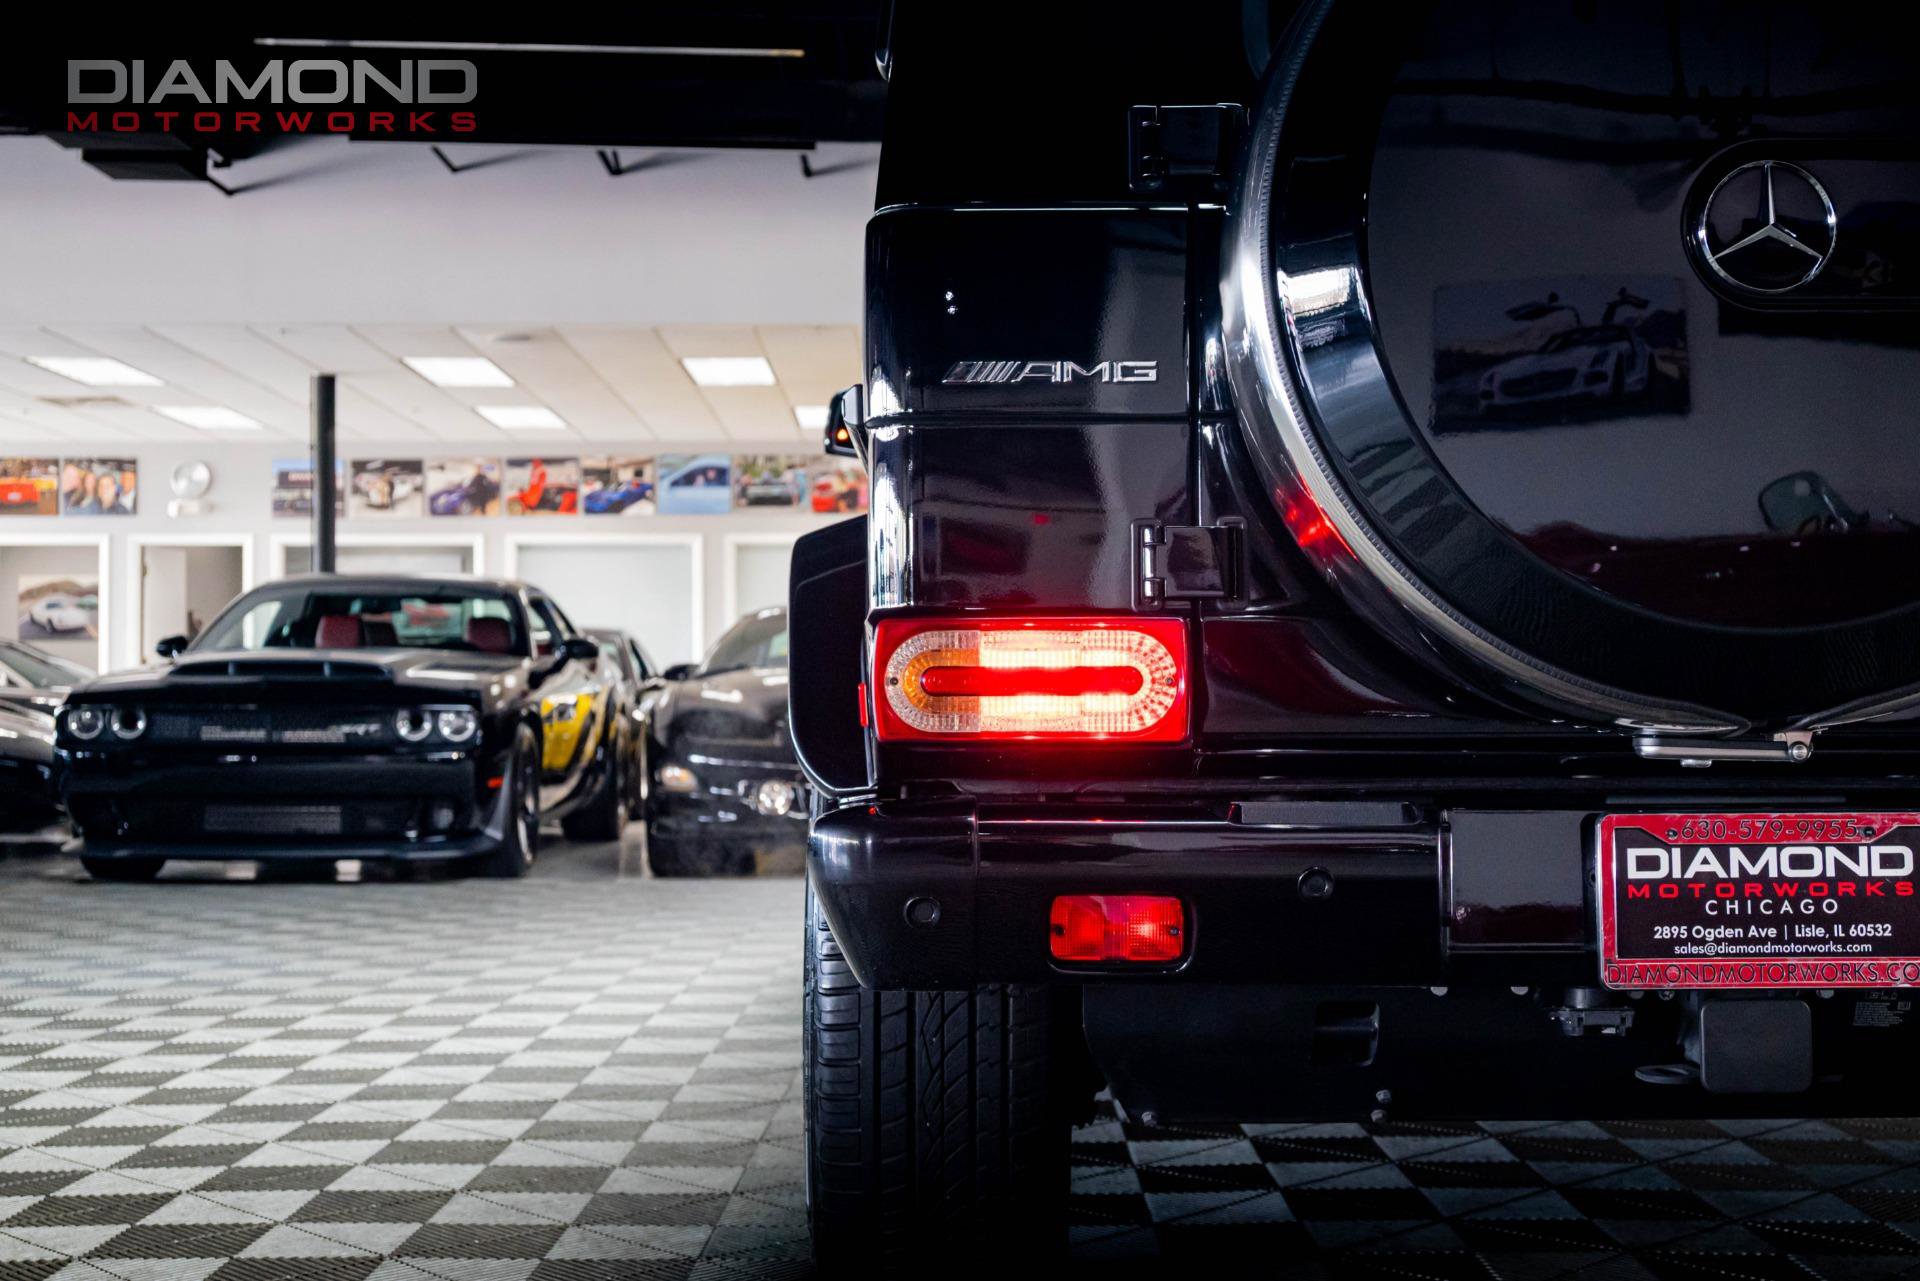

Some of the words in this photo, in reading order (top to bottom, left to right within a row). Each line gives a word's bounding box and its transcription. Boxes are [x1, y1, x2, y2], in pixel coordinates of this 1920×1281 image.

[1681, 818, 1858, 841] 630-579-9955
[1626, 845, 1914, 879] DIAMOND
[1628, 881, 1914, 898] MOTORWORKS
[1705, 899, 1839, 915] CHICAGO
[1653, 925, 1688, 939] 2895
[1692, 924, 1744, 942] Ogden
[1748, 925, 1777, 938] Ave
[1795, 923, 1830, 939] Lisle,
[1833, 924, 1845, 937] IL
[1849, 923, 1892, 937] 60532
[1674, 941, 1872, 955] sales@diamondmotorworks.com
